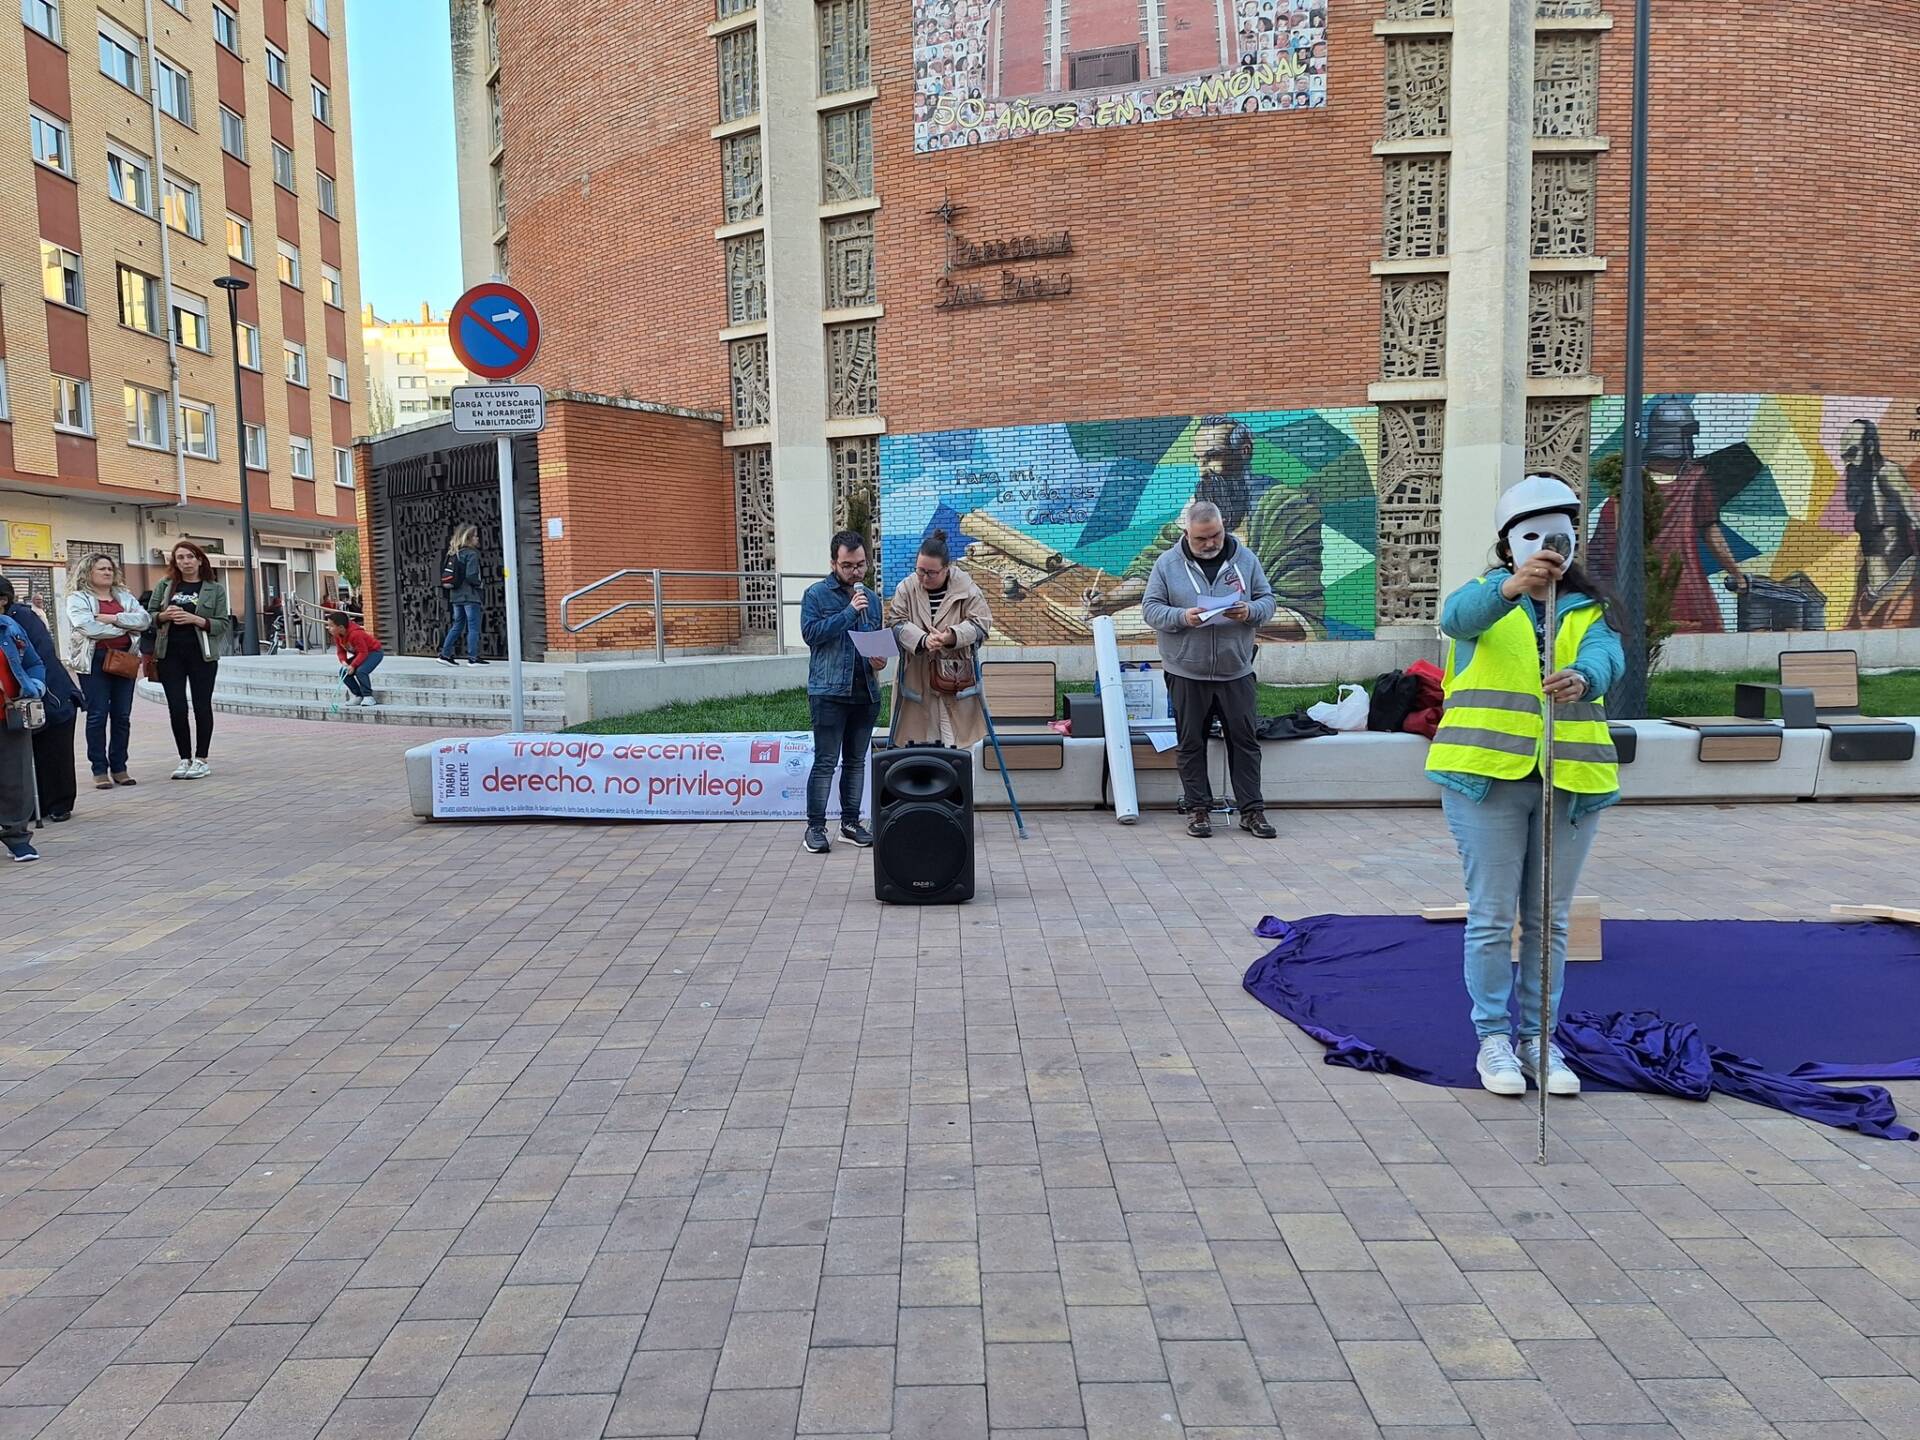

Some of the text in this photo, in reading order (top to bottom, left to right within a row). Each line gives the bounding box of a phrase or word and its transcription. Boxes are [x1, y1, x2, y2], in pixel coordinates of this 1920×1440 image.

[932, 52, 1308, 130] 50 AÑOS EN GAMONAL
[474, 390, 519, 398] EXCLUSIVO
[956, 468, 1001, 485] Para
[1020, 480, 1063, 501] vida
[1072, 486, 1095, 499] es
[1025, 505, 1088, 525] Cristo
[507, 740, 604, 767] Trabajo
[445, 764, 457, 798] TRABAJO
[460, 762, 469, 797] DECENTE
[482, 766, 763, 806] derecho, no privilegio
